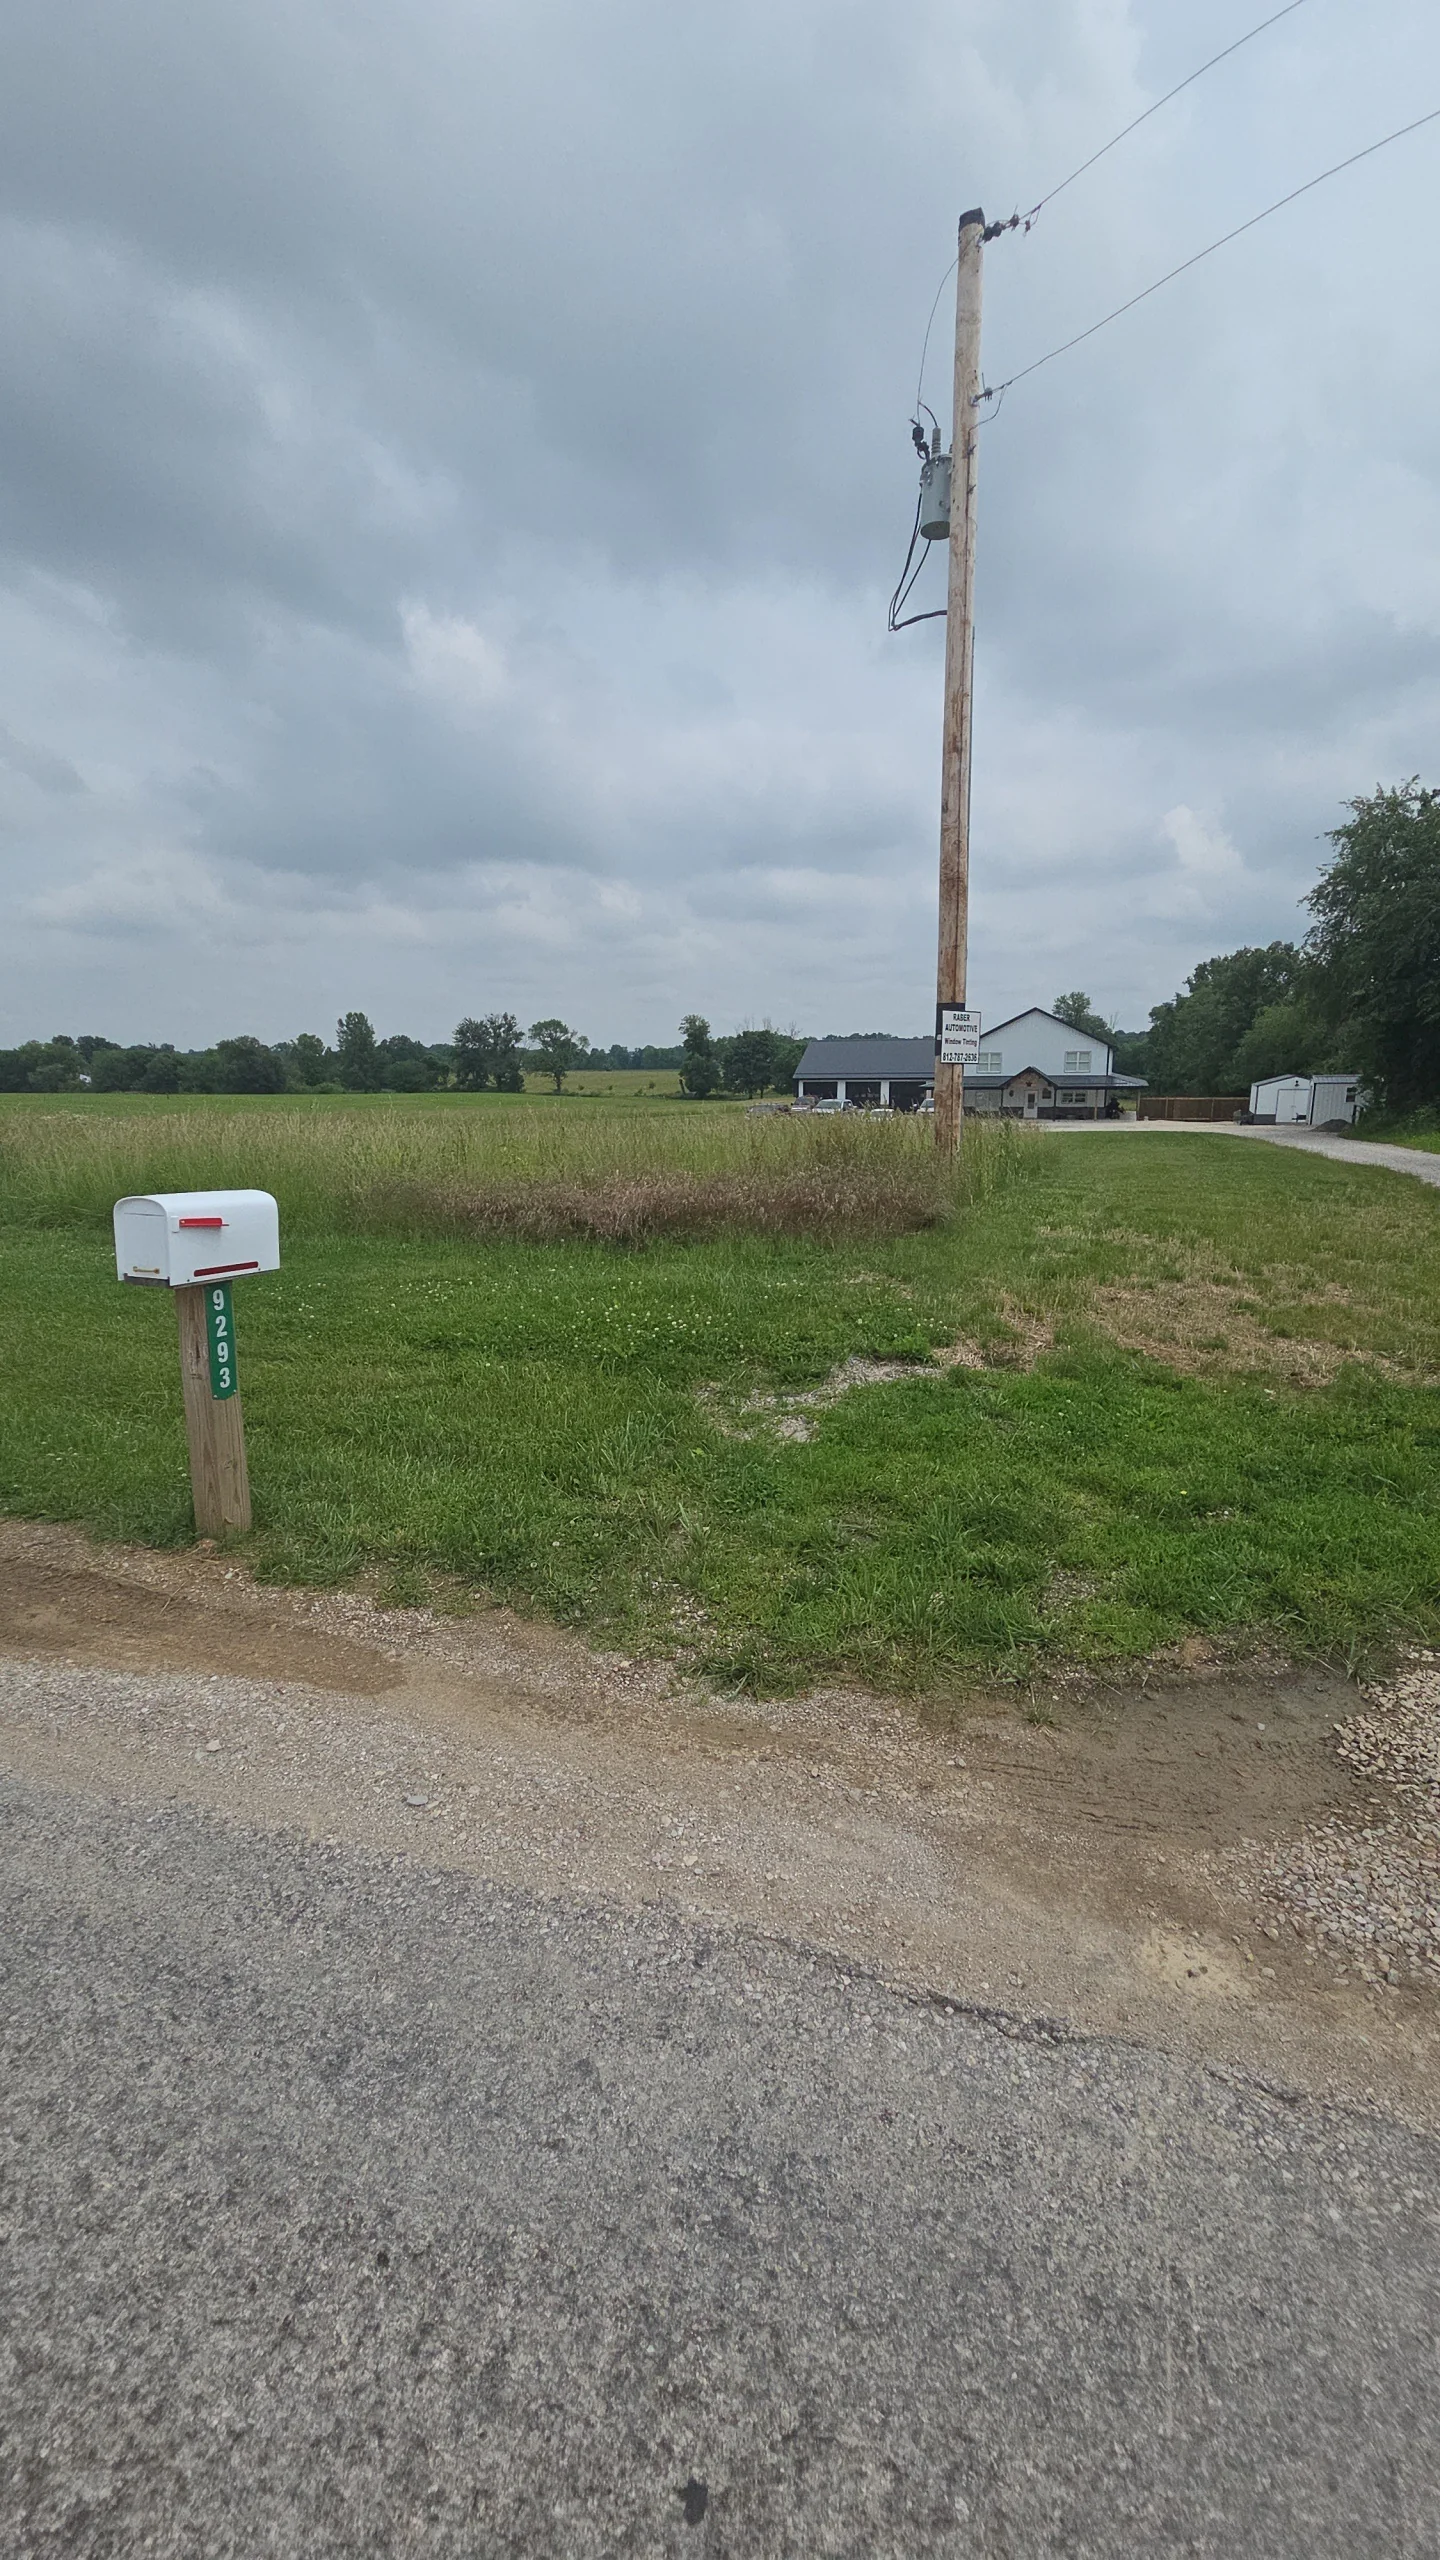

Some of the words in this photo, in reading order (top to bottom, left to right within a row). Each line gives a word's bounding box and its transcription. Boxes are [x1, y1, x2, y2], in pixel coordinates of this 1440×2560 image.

[953, 1013, 970, 1021] RABER
[945, 1024, 978, 1033] AUTOMOTIVE
[962, 1038, 977, 1047] Tinting
[212, 1289, 231, 1389] 9293
